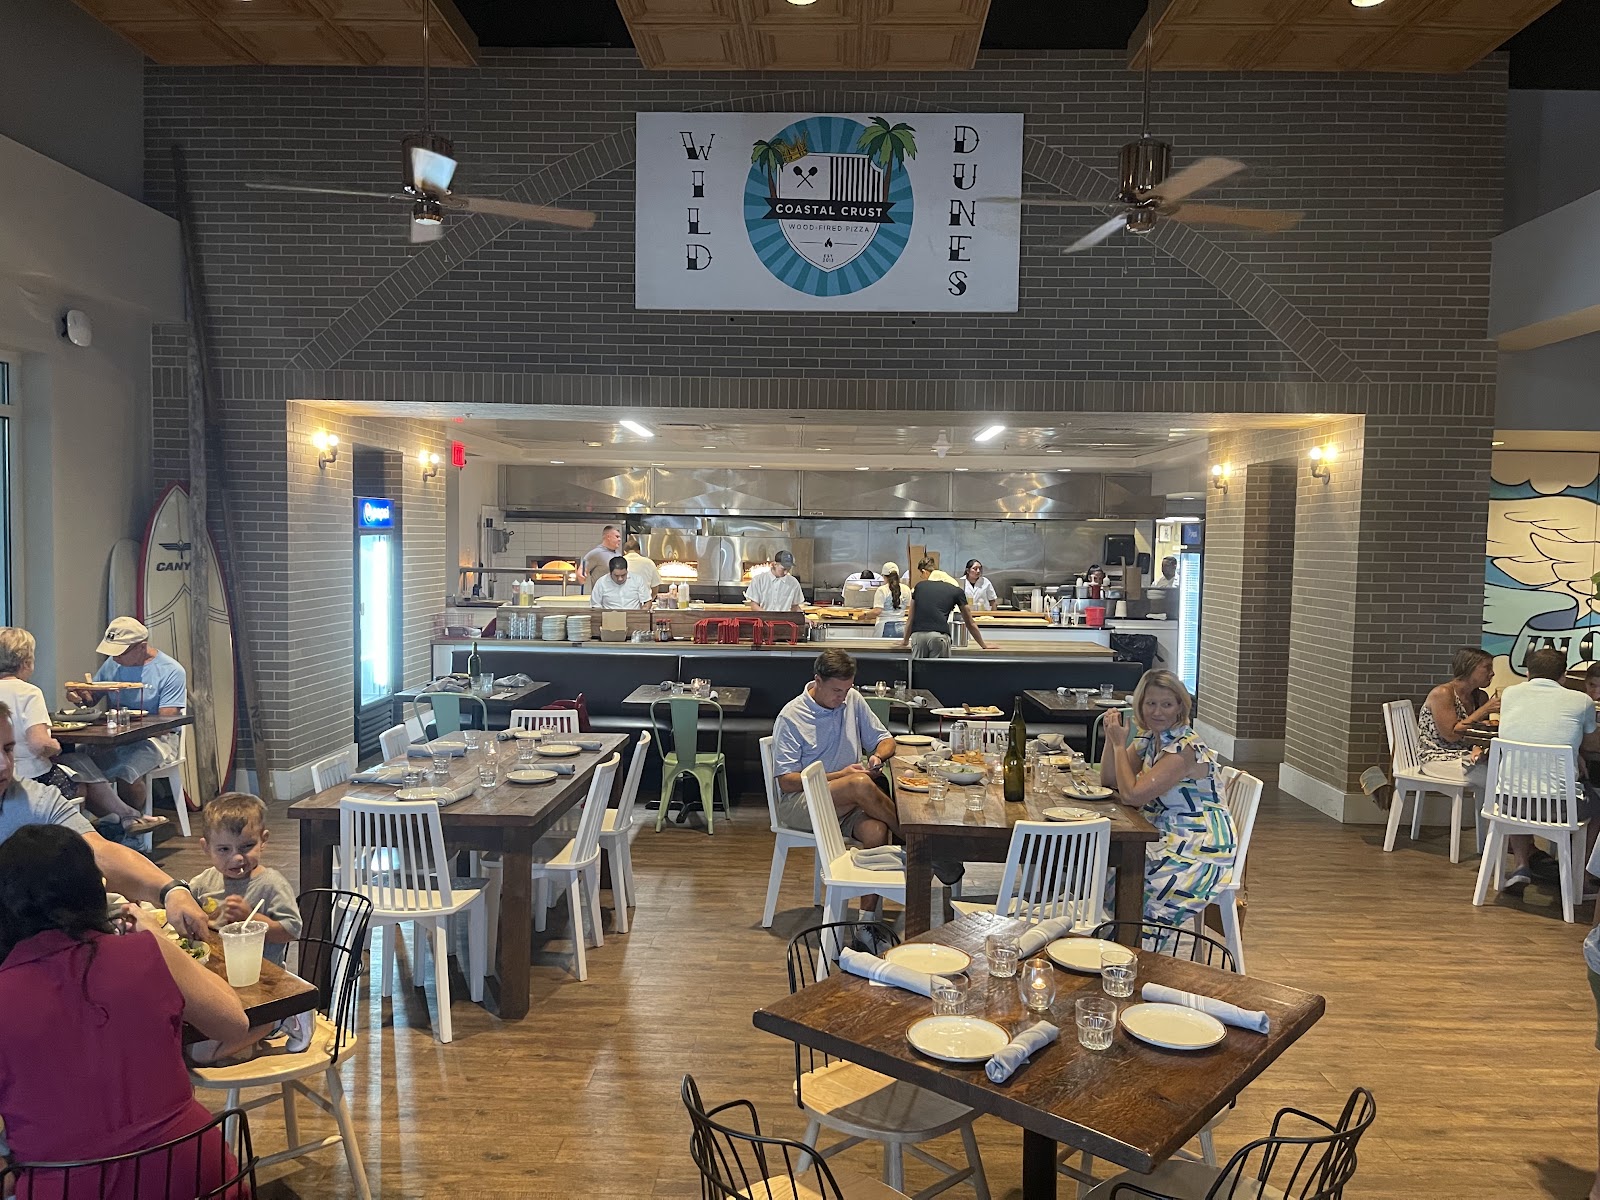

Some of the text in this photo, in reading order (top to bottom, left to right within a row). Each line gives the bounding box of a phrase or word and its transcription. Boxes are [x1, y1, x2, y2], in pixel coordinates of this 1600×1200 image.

[679, 131, 716, 271] WILD
[775, 203, 883, 218] COASTAL CRUST
[788, 223, 843, 232] WOOD-FIRED
[948, 125, 980, 297] DUNES
